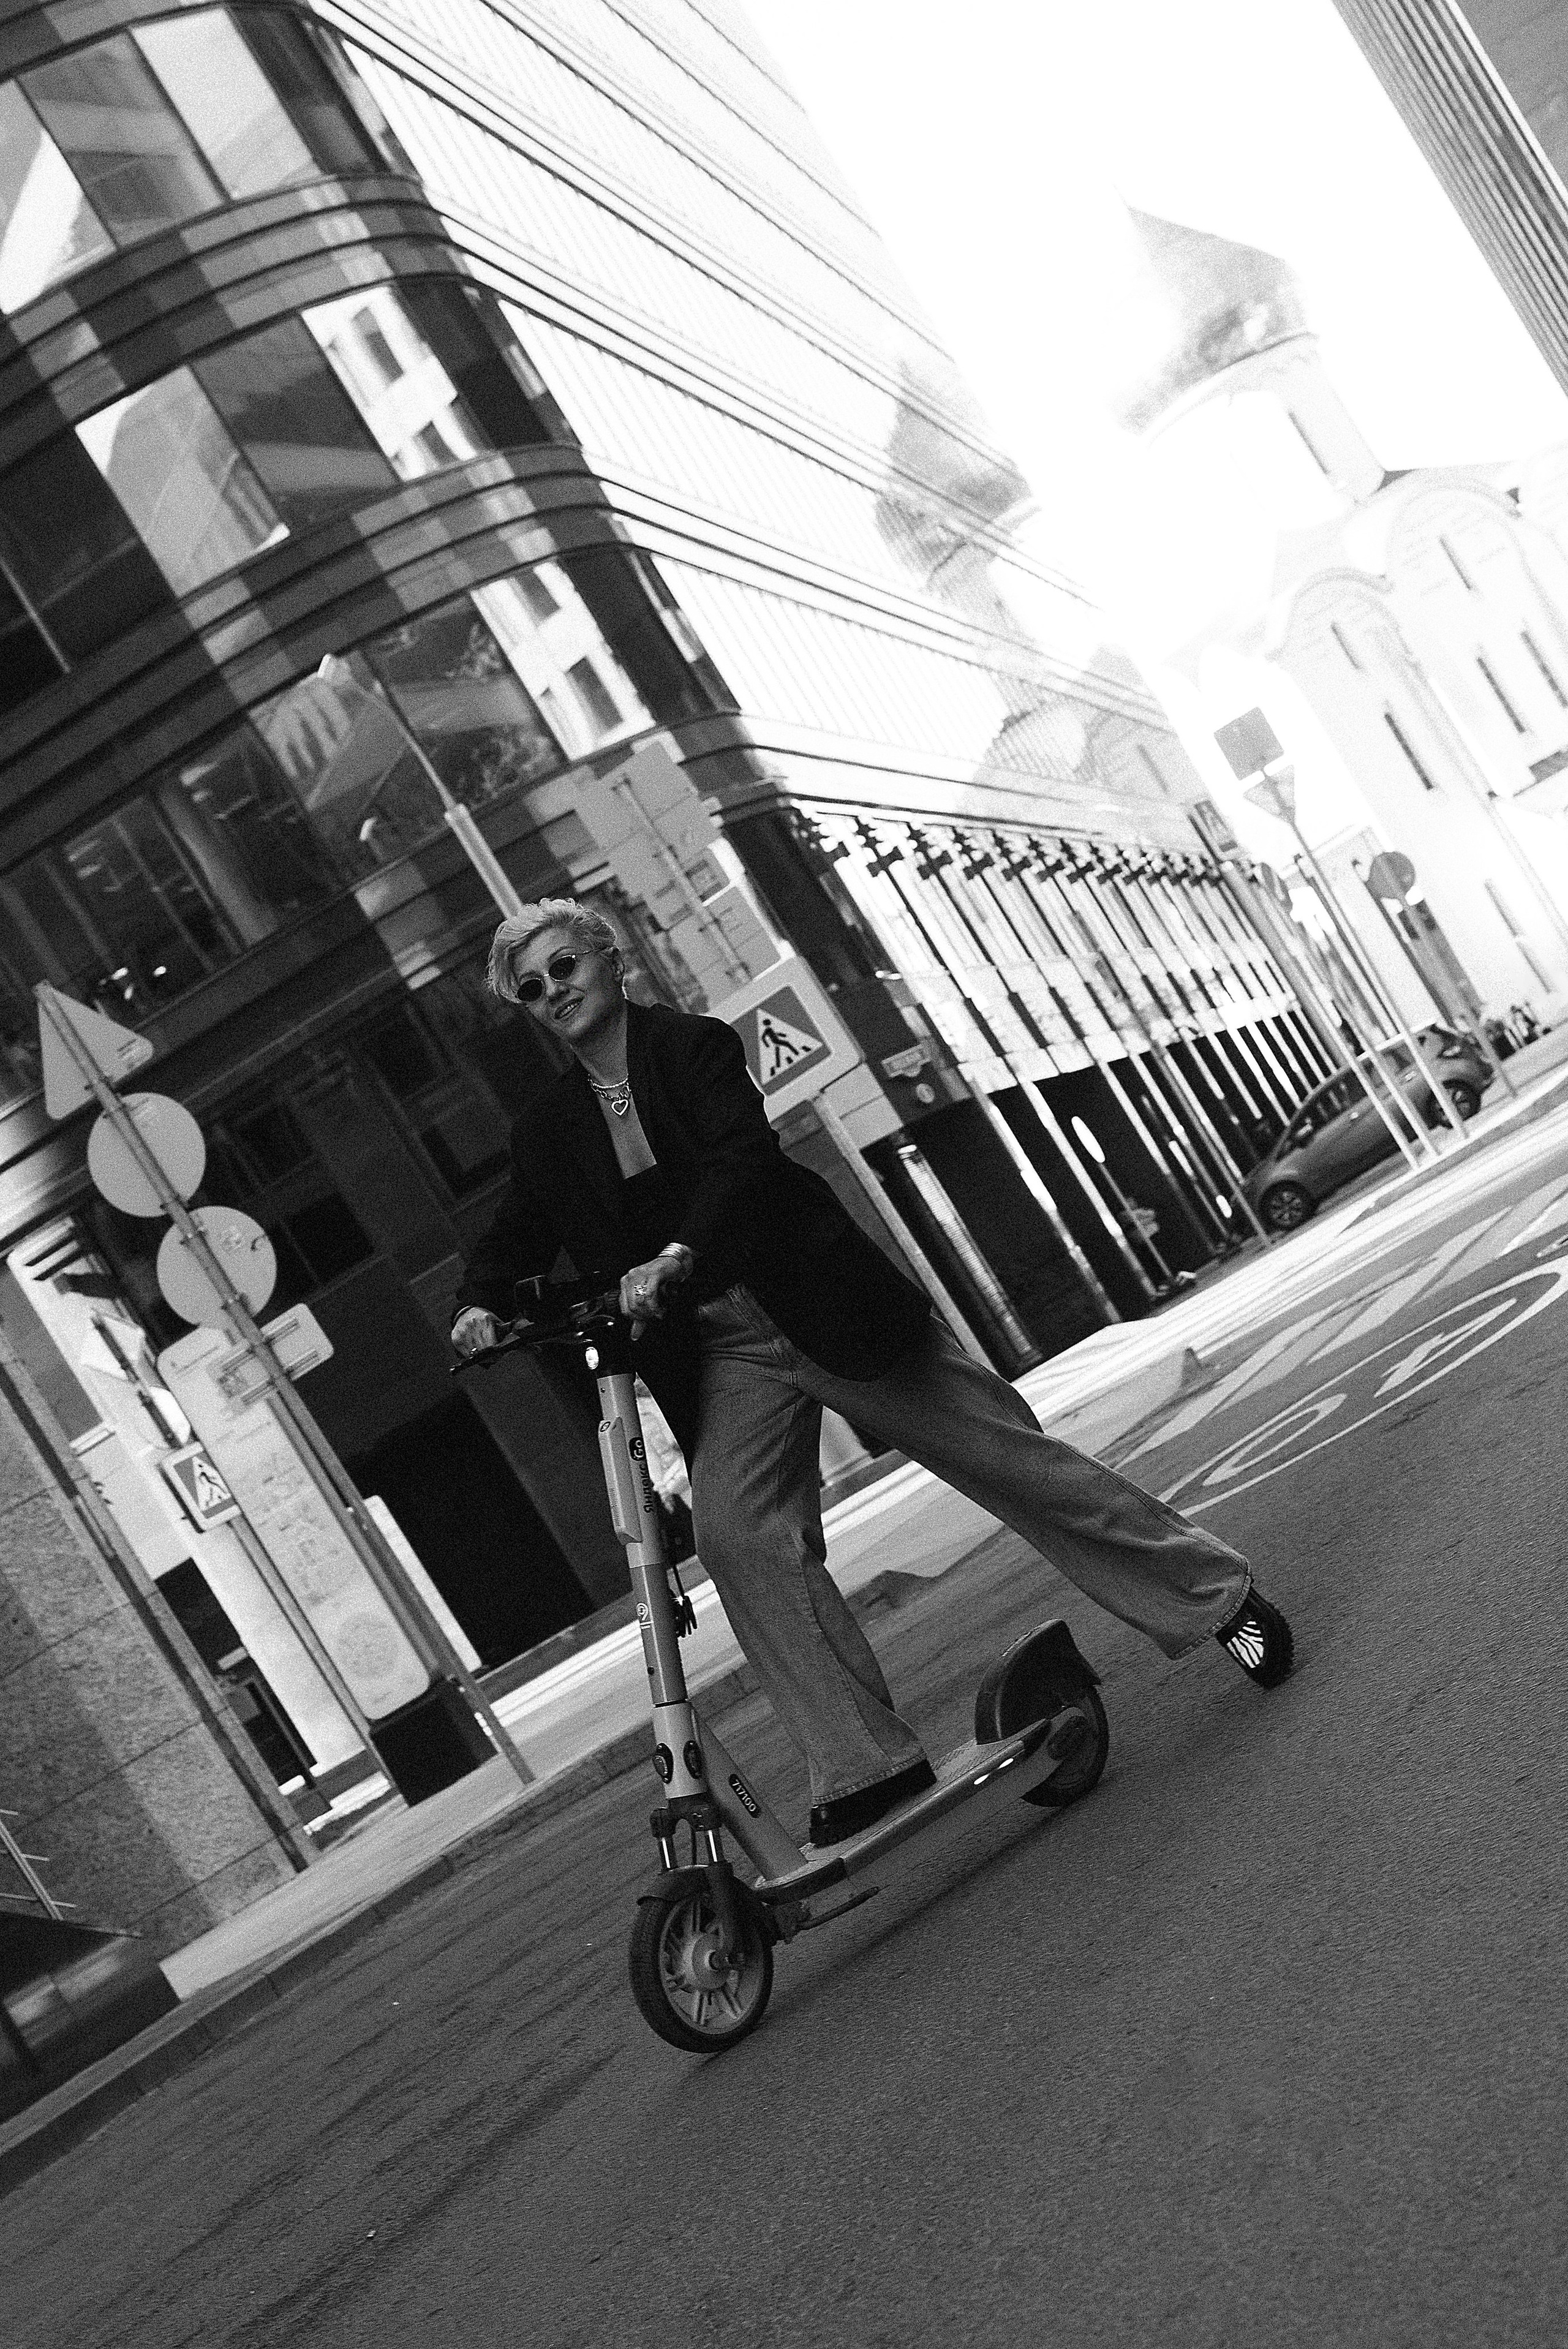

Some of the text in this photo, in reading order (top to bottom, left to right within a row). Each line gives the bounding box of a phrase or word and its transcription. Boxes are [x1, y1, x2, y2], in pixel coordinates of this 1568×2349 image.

[1202, 1298, 1517, 1487] 40
[634, 1440, 654, 1513] Яндекс Go
[732, 1779, 756, 1811] 717100
